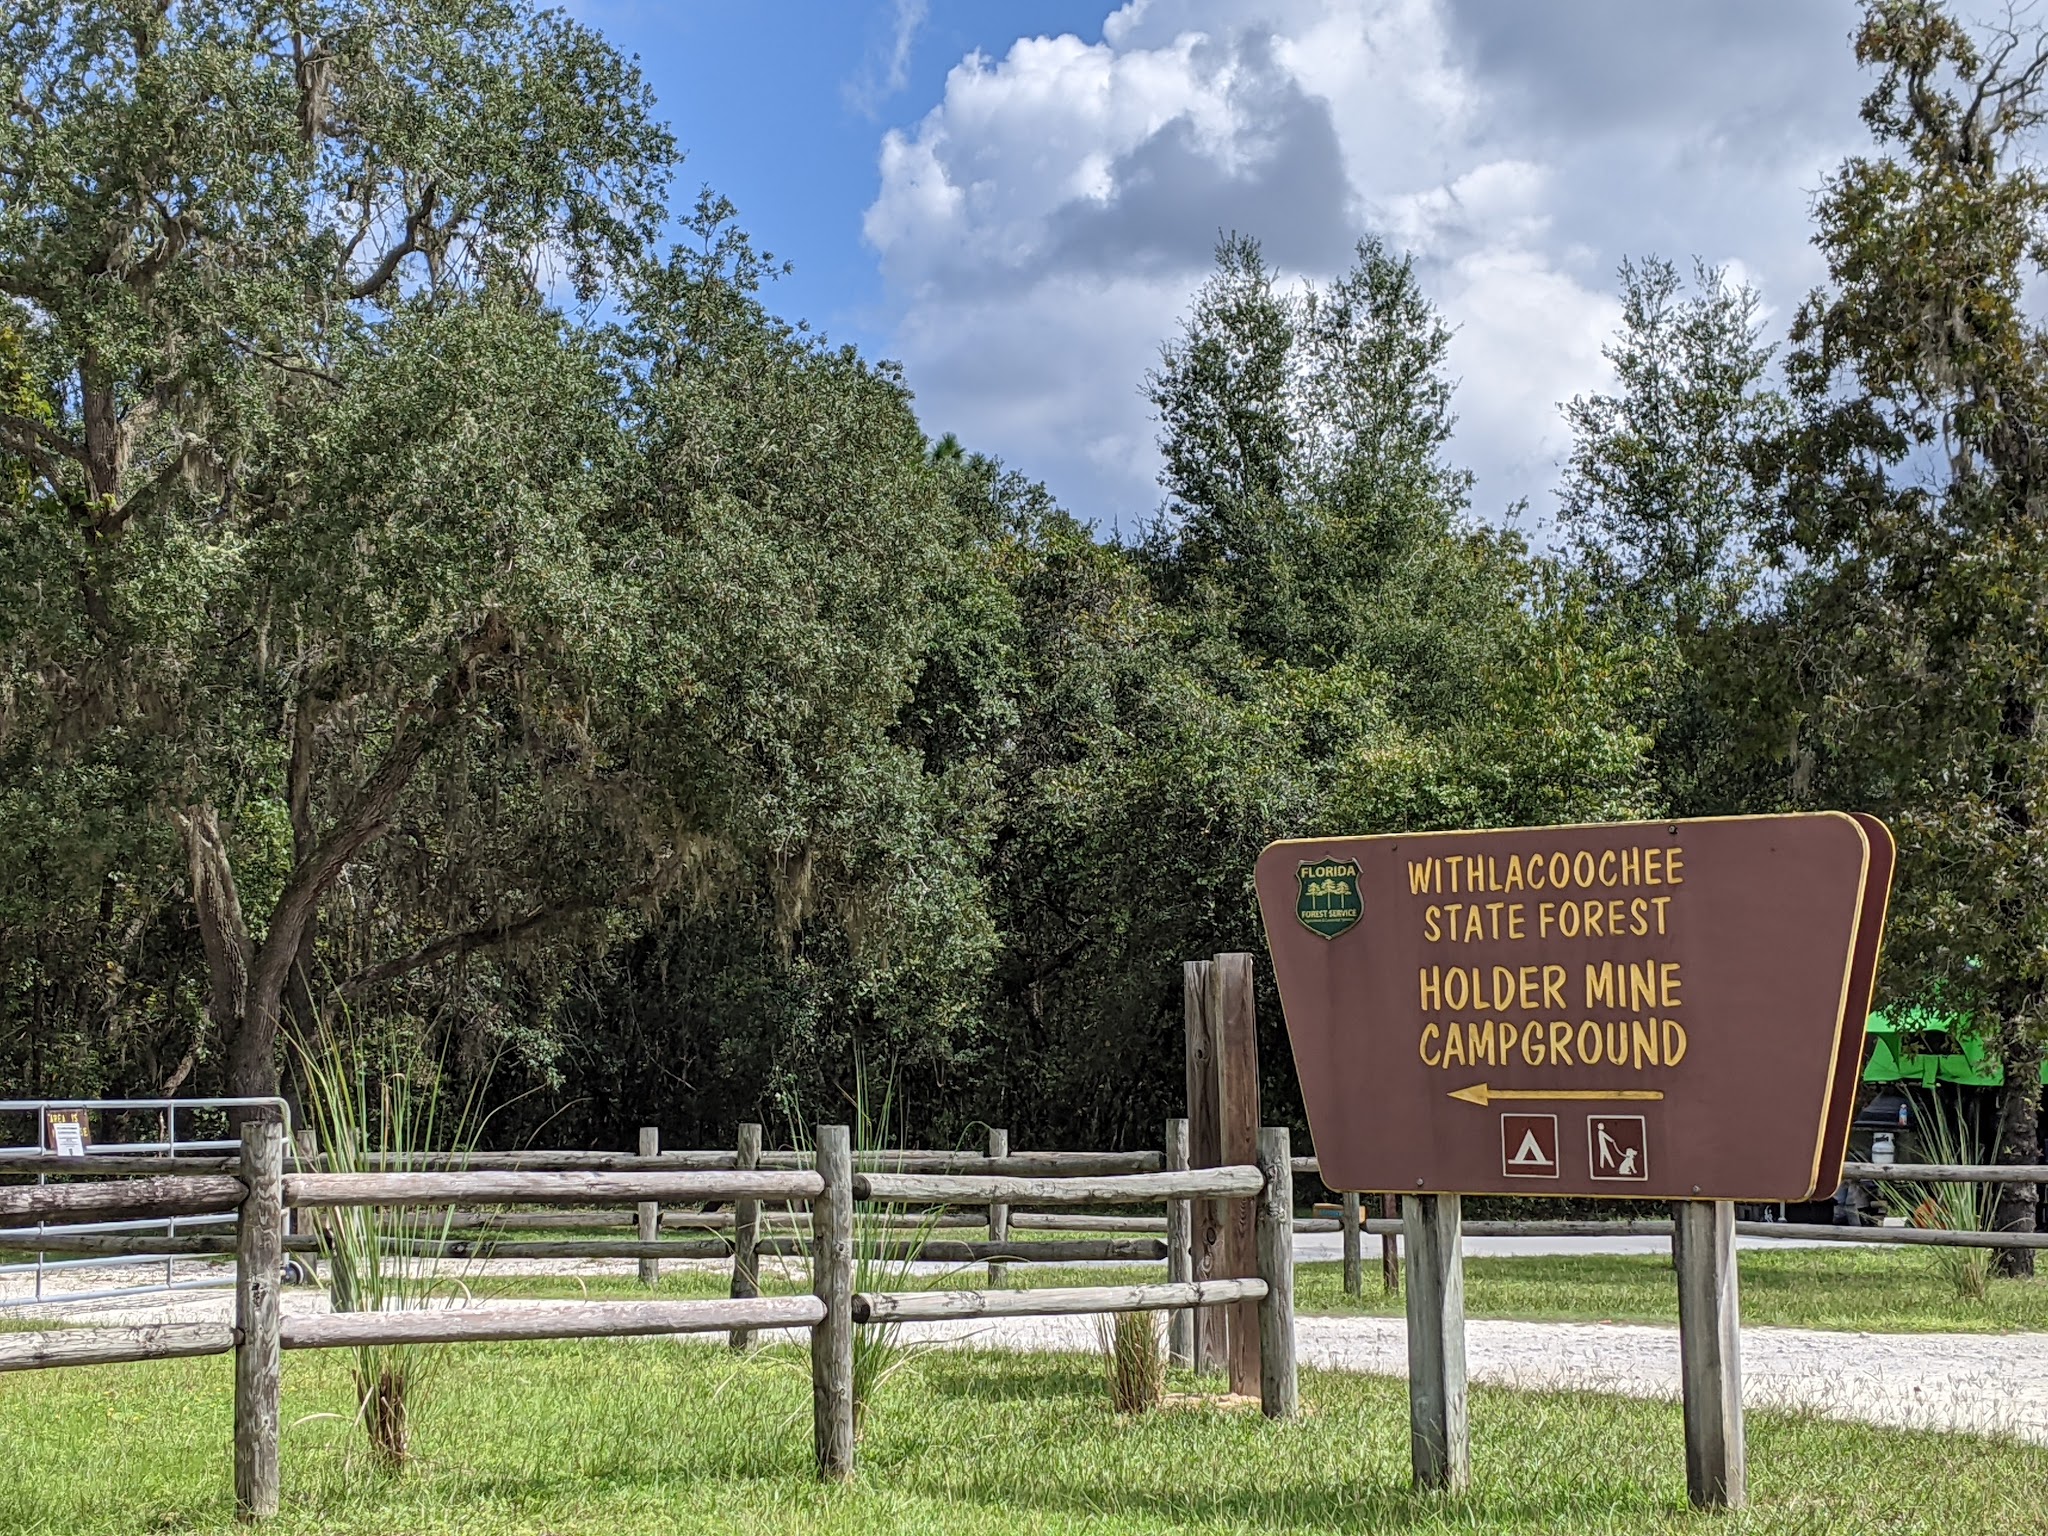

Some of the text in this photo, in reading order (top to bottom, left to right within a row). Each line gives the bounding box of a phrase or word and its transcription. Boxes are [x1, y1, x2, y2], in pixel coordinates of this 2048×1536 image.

[1301, 865, 1356, 878] FLORIDA
[1408, 847, 1684, 895] WITHLACOOCHEE
[1301, 908, 1358, 918] FOREST SERVICE
[1424, 896, 1671, 943] STATE FOREST
[1420, 959, 1682, 1012] HOLDER MINE
[1419, 1017, 1687, 1070] CAMPGROUND
